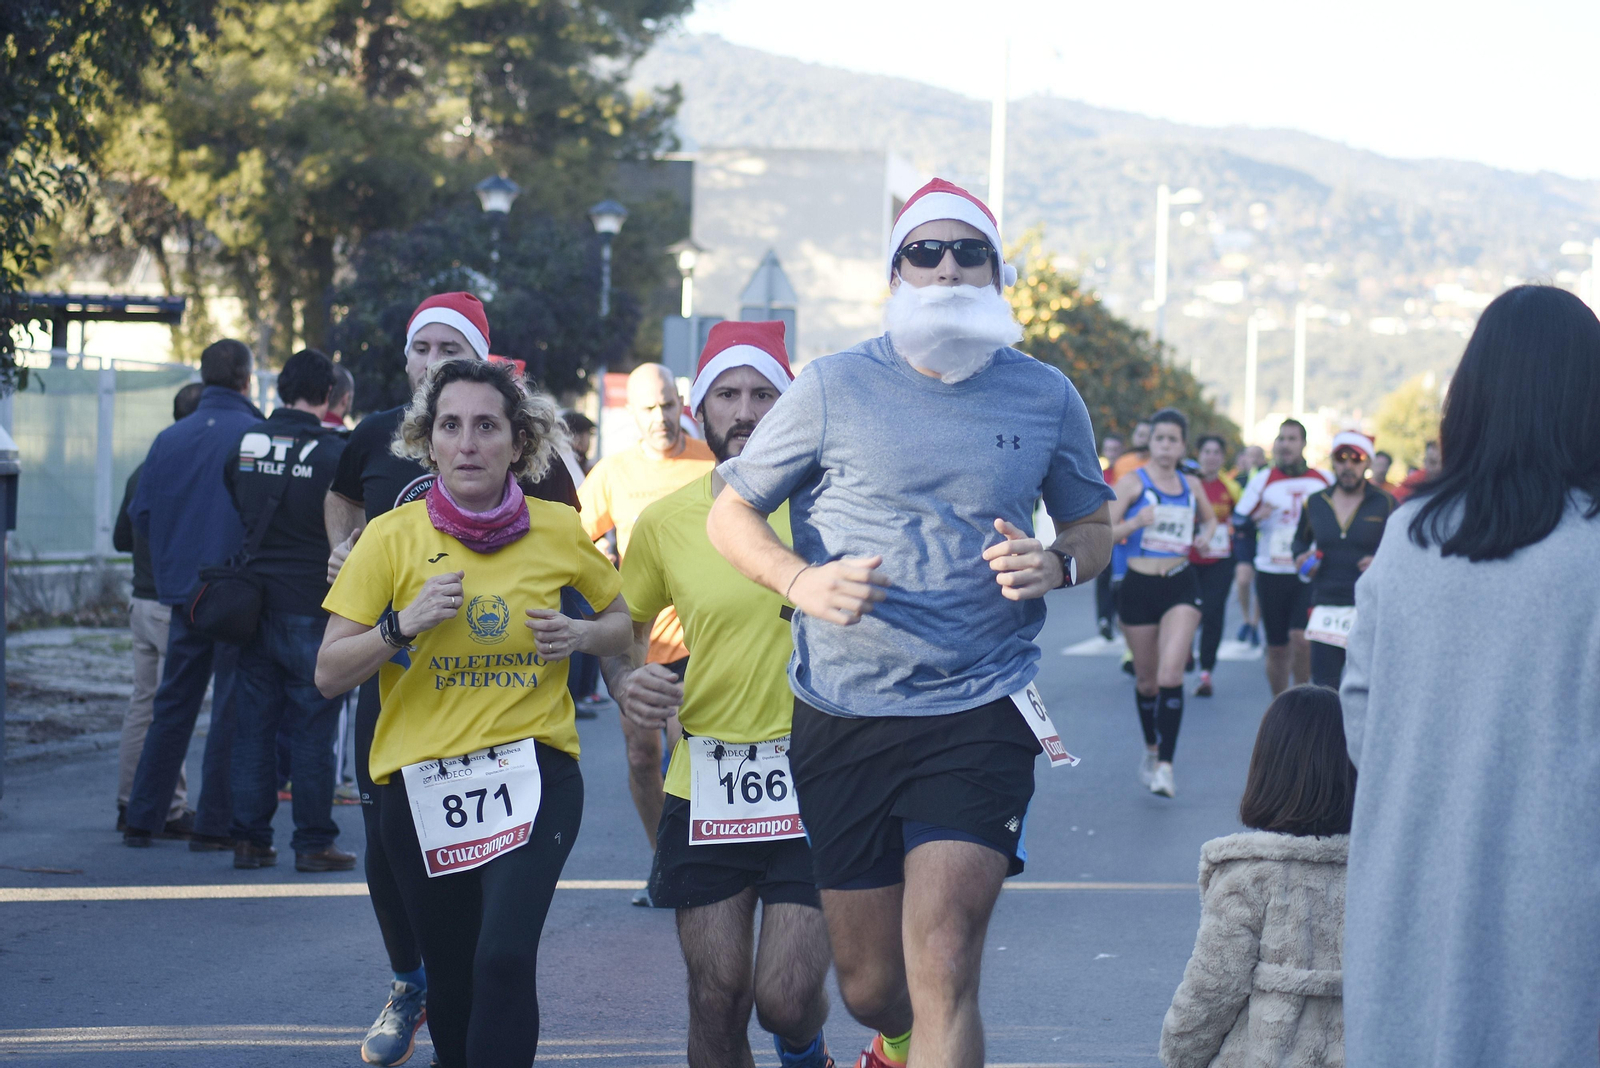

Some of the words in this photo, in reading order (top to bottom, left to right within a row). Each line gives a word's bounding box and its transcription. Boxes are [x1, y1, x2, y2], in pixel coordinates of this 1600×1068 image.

[257, 461, 313, 478] TELEOM
[428, 652, 548, 671] ATLETISMO
[435, 671, 538, 691] ESTEPONA
[444, 759, 457, 767] San
[442, 783, 513, 828] 871
[701, 818, 792, 836] Cruzcampo
[436, 832, 514, 866] Cruzcampo
